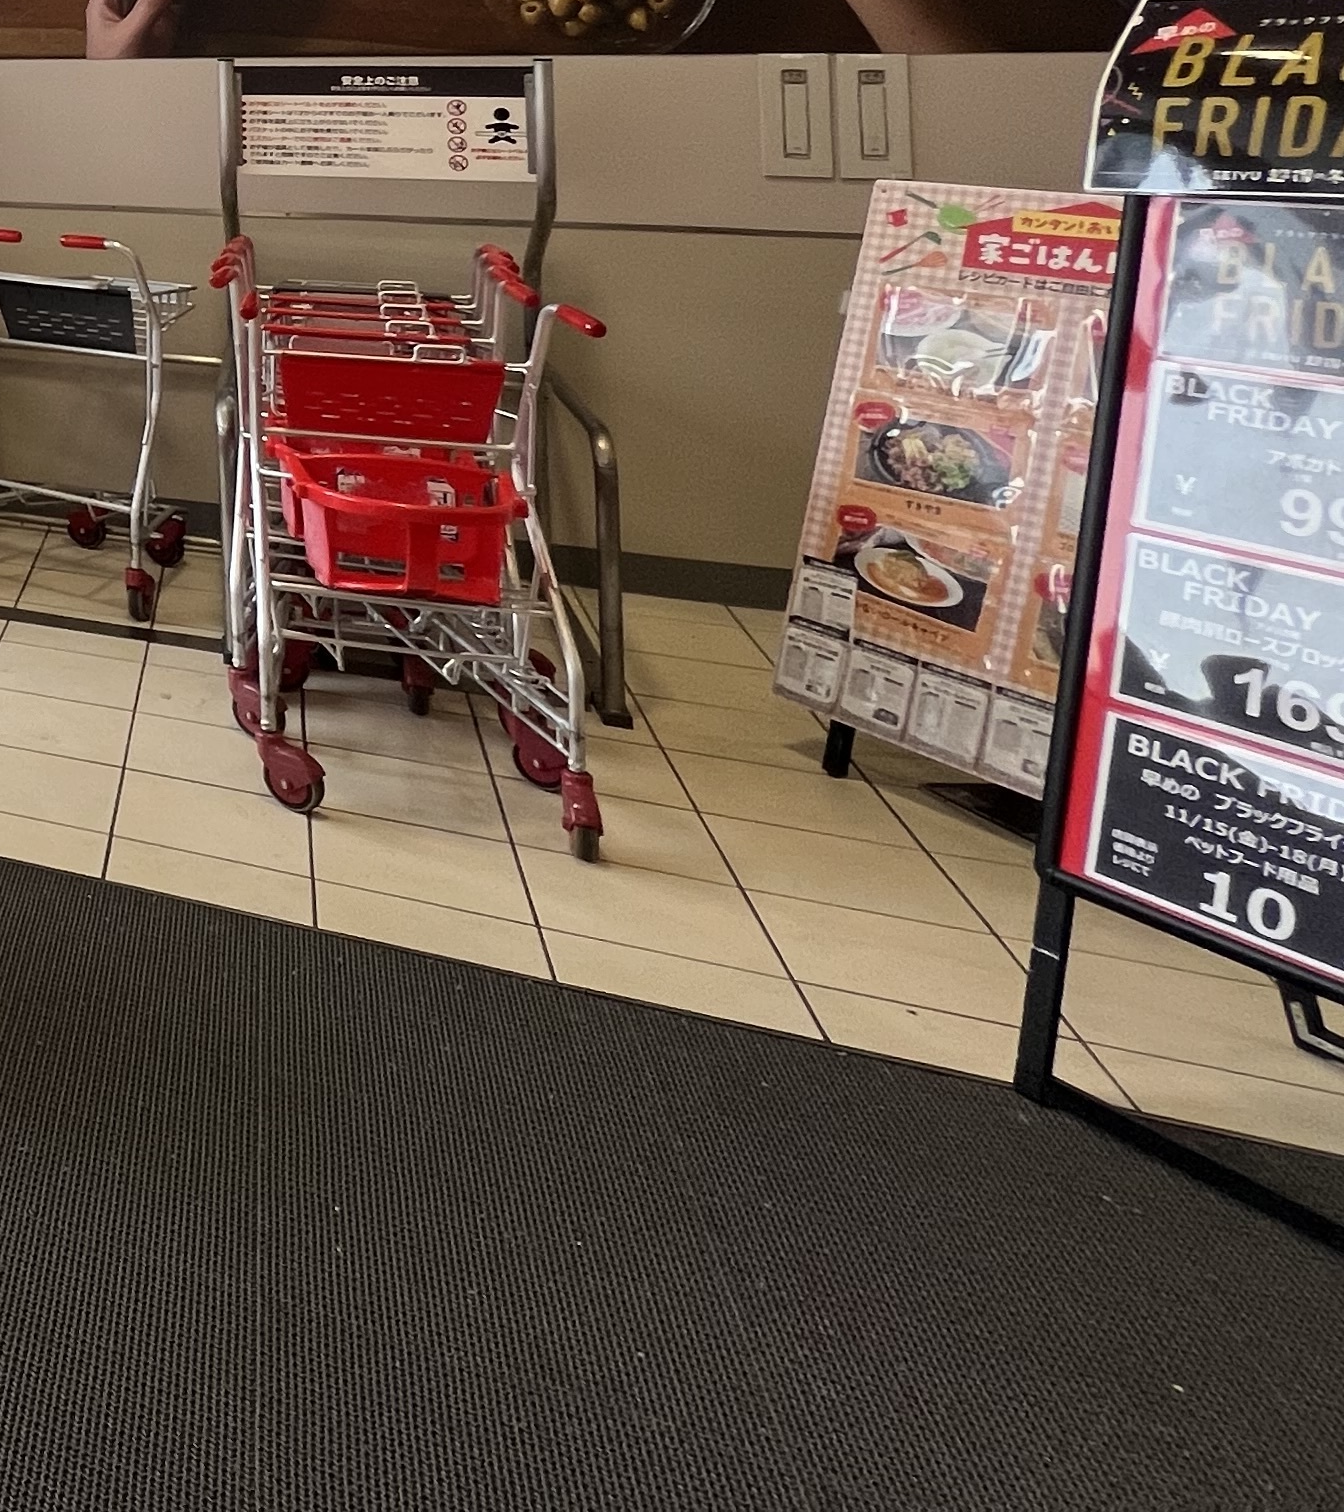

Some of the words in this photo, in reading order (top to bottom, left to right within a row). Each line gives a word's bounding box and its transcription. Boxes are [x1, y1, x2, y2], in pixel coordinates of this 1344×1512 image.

[1162, 31, 1344, 88] BLA
[1165, 374, 1275, 410] BLACK
[1207, 401, 1344, 440] FRIDAY
[1138, 547, 1252, 593] BLACK
[1183, 580, 1322, 631] FRIDAY
[1127, 732, 1247, 791] BLACK
[1198, 870, 1297, 942] 10
